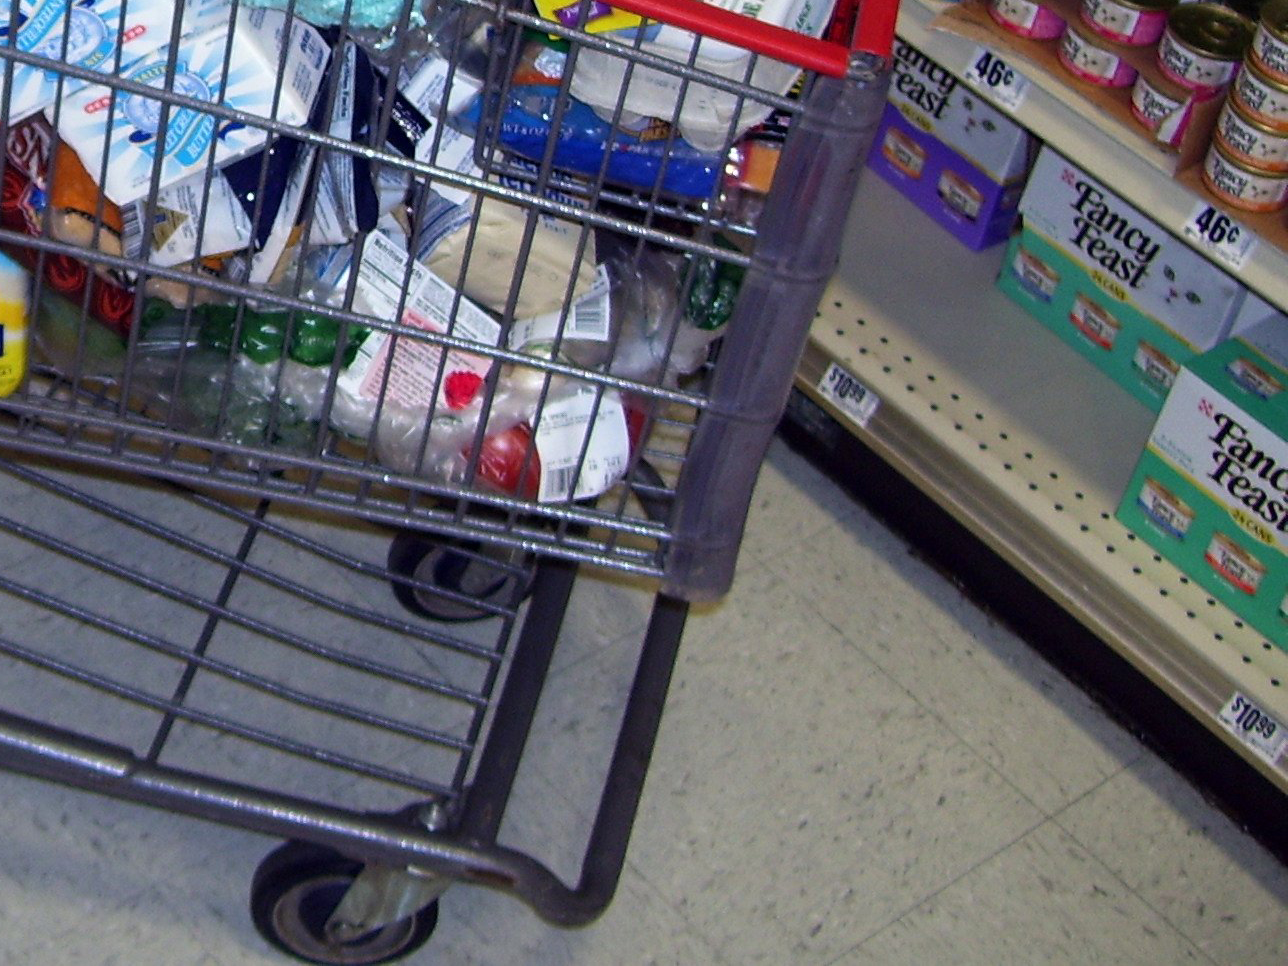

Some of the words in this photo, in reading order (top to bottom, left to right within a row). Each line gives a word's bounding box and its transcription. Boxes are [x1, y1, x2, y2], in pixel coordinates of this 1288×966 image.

[896, 44, 959, 95] ancy
[373, 236, 405, 266] Nutrition
[1069, 215, 1151, 289] Feast
[1070, 180, 1161, 264] Fancy
[1208, 412, 1288, 493] Fanc
